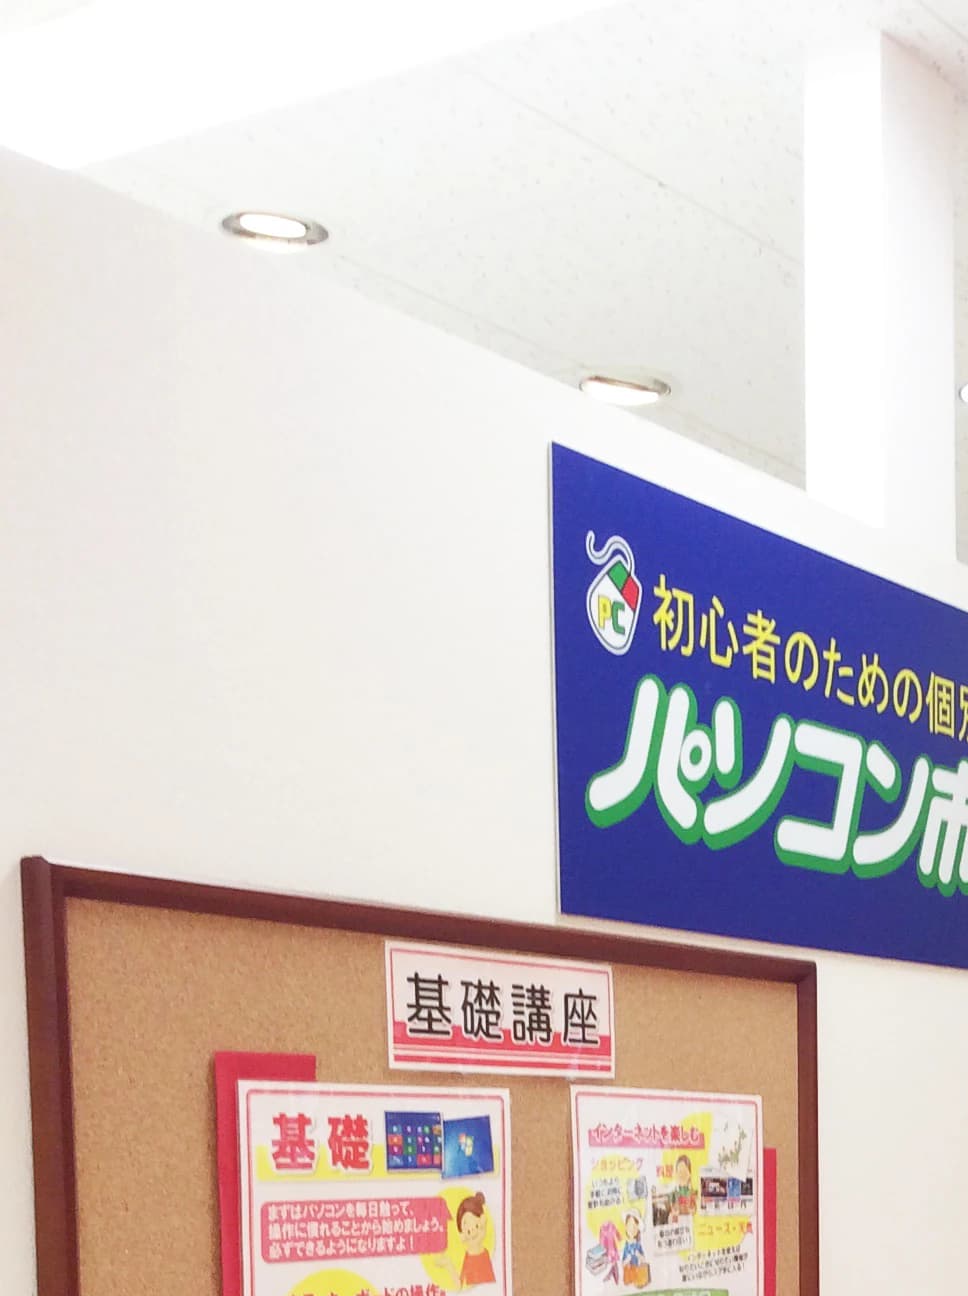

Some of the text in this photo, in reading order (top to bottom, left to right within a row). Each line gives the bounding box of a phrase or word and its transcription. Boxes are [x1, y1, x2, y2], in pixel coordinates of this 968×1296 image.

[597, 595, 626, 634] PC
[406, 971, 599, 1045] 基礎講座
[271, 1112, 370, 1171] 基礎
